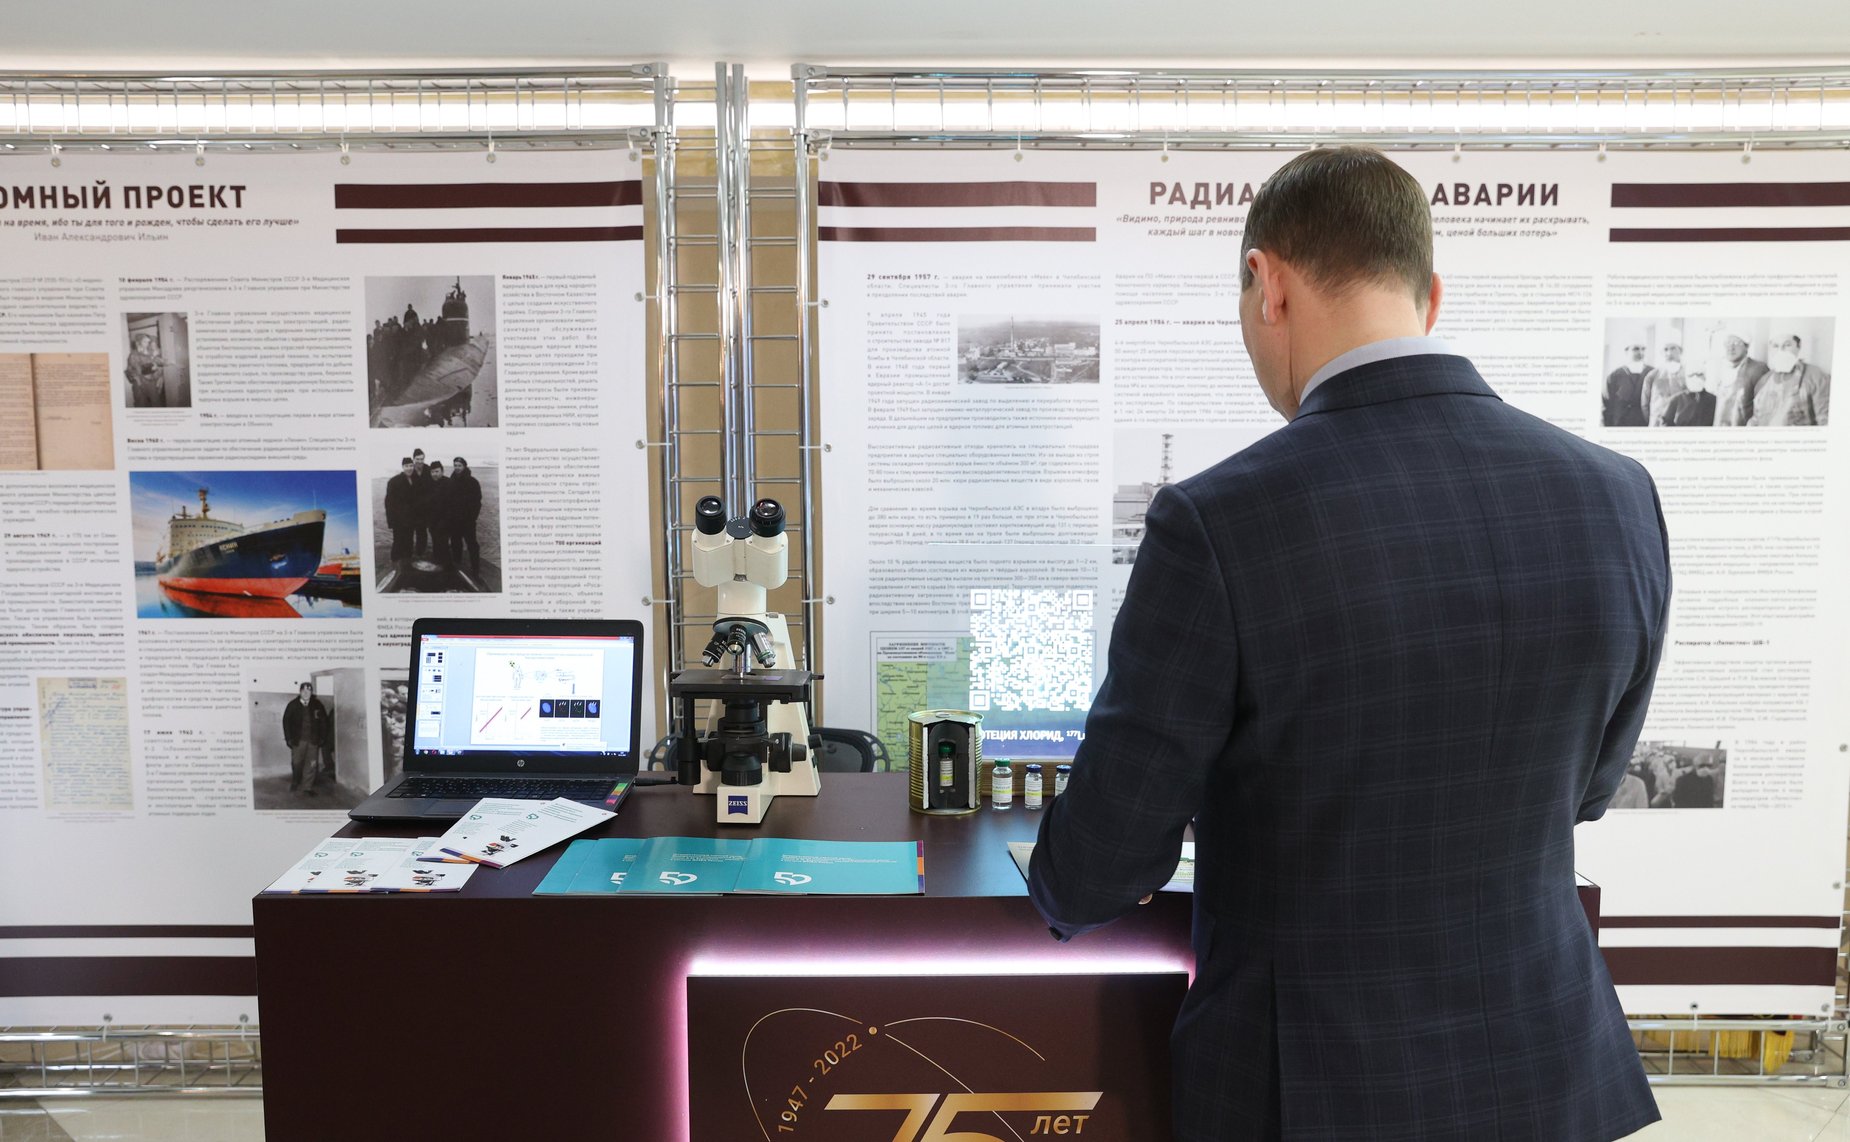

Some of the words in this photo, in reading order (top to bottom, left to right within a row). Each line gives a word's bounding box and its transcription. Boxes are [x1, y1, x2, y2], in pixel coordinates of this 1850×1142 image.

[123, 185, 246, 209] ПРОЕКТ
[1150, 182, 1262, 210] РАДИА
[1431, 183, 1558, 206] АВАРИИ
[34, 232, 58, 240] Иван
[138, 232, 168, 240] Ильин
[1020, 730, 1064, 742] ХЛОРИД,
[778, 1085, 808, 1132] 1947
[814, 1034, 862, 1075] 2022
[1030, 1115, 1090, 1134] лет
